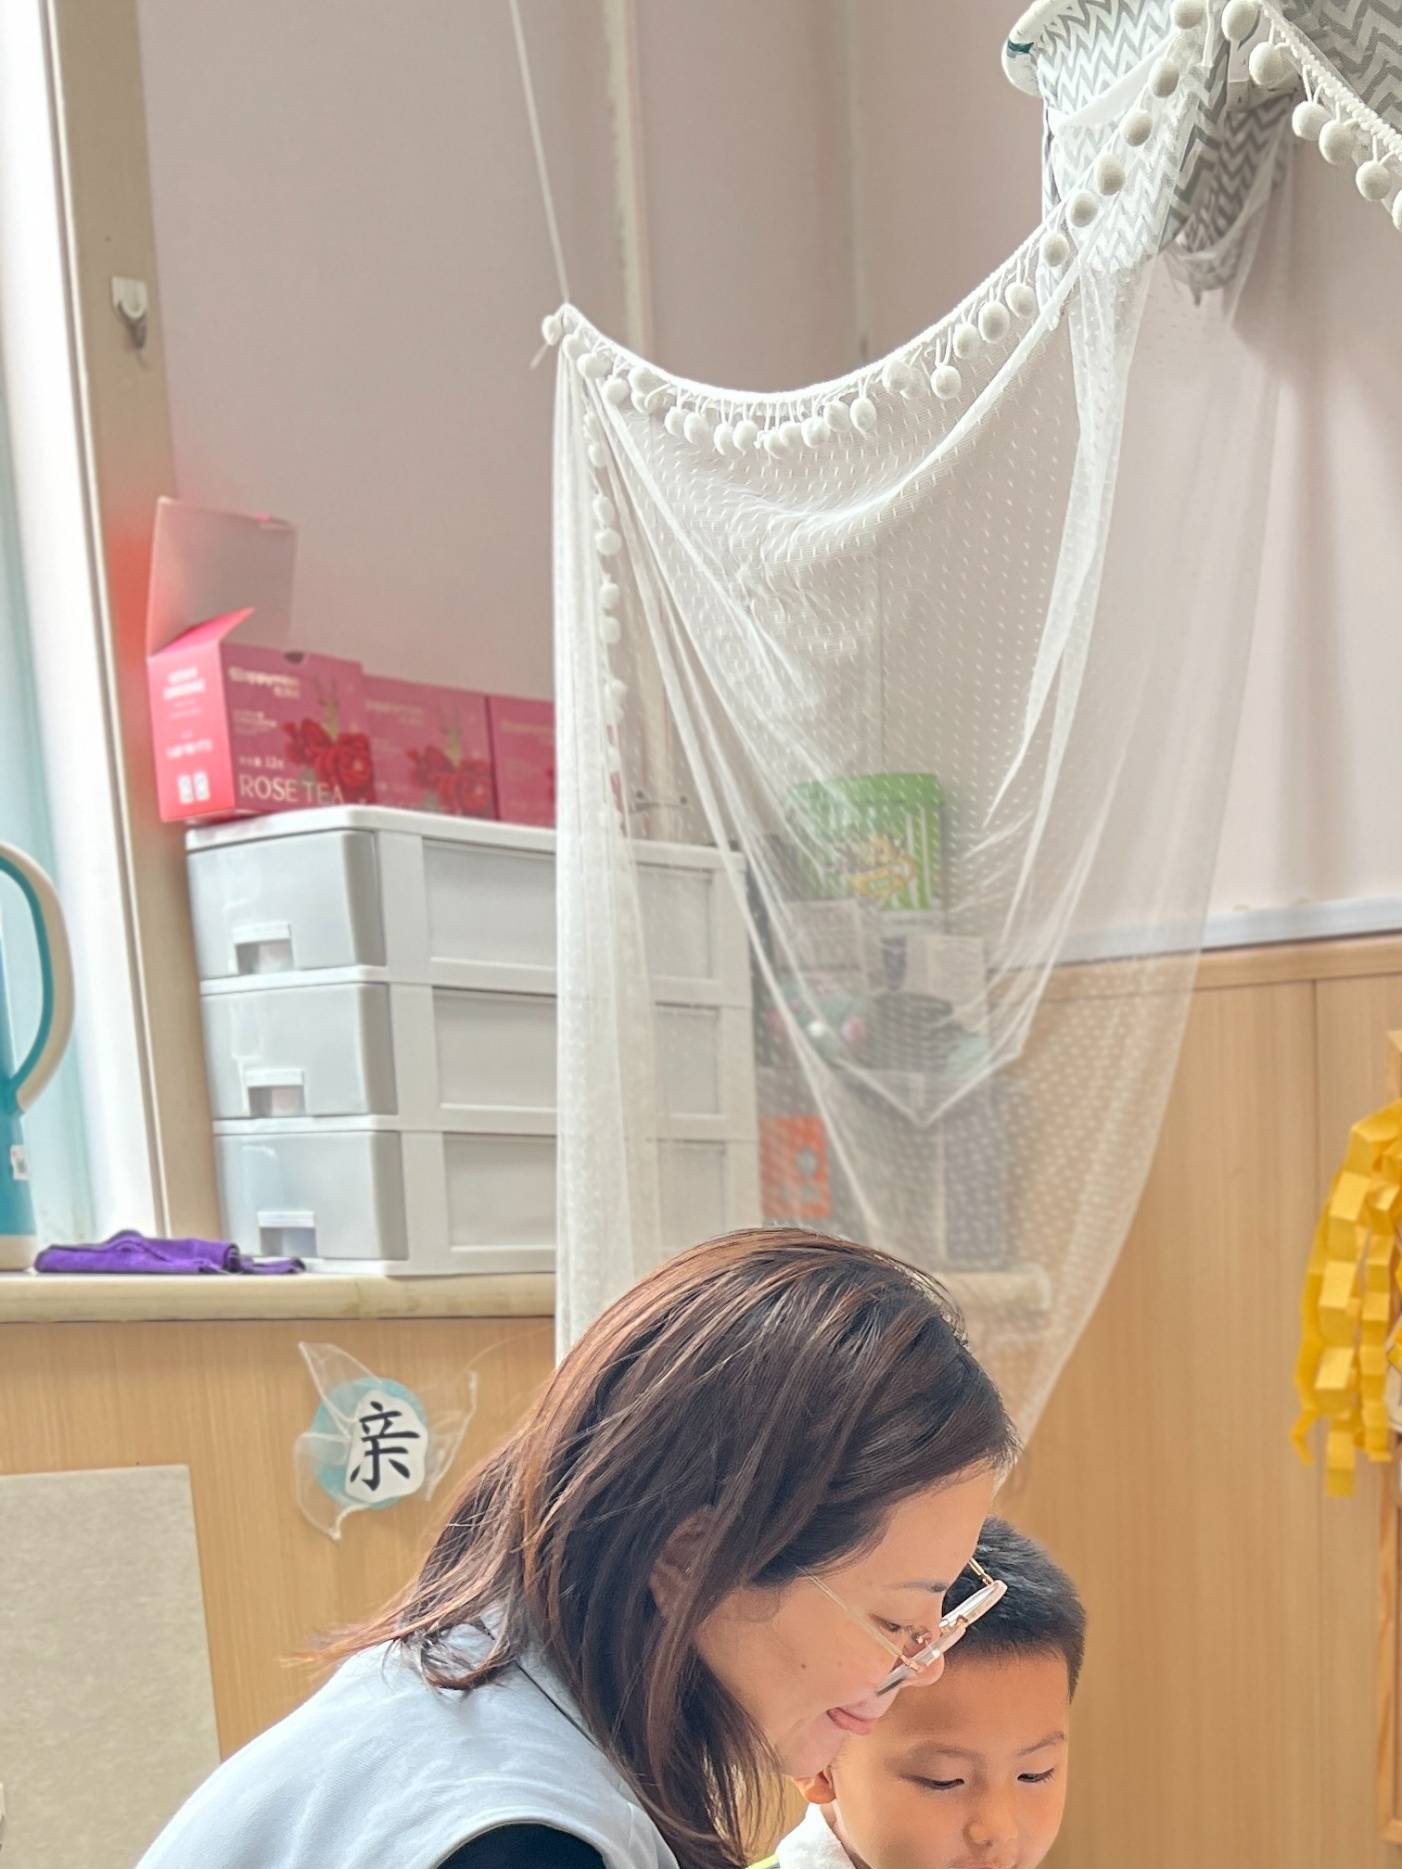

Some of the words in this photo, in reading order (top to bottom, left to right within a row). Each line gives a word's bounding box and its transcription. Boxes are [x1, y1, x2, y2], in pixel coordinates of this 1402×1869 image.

[239, 773, 298, 802] ROSE
[303, 781, 344, 805] TEA
[350, 1401, 420, 1491] 亲
